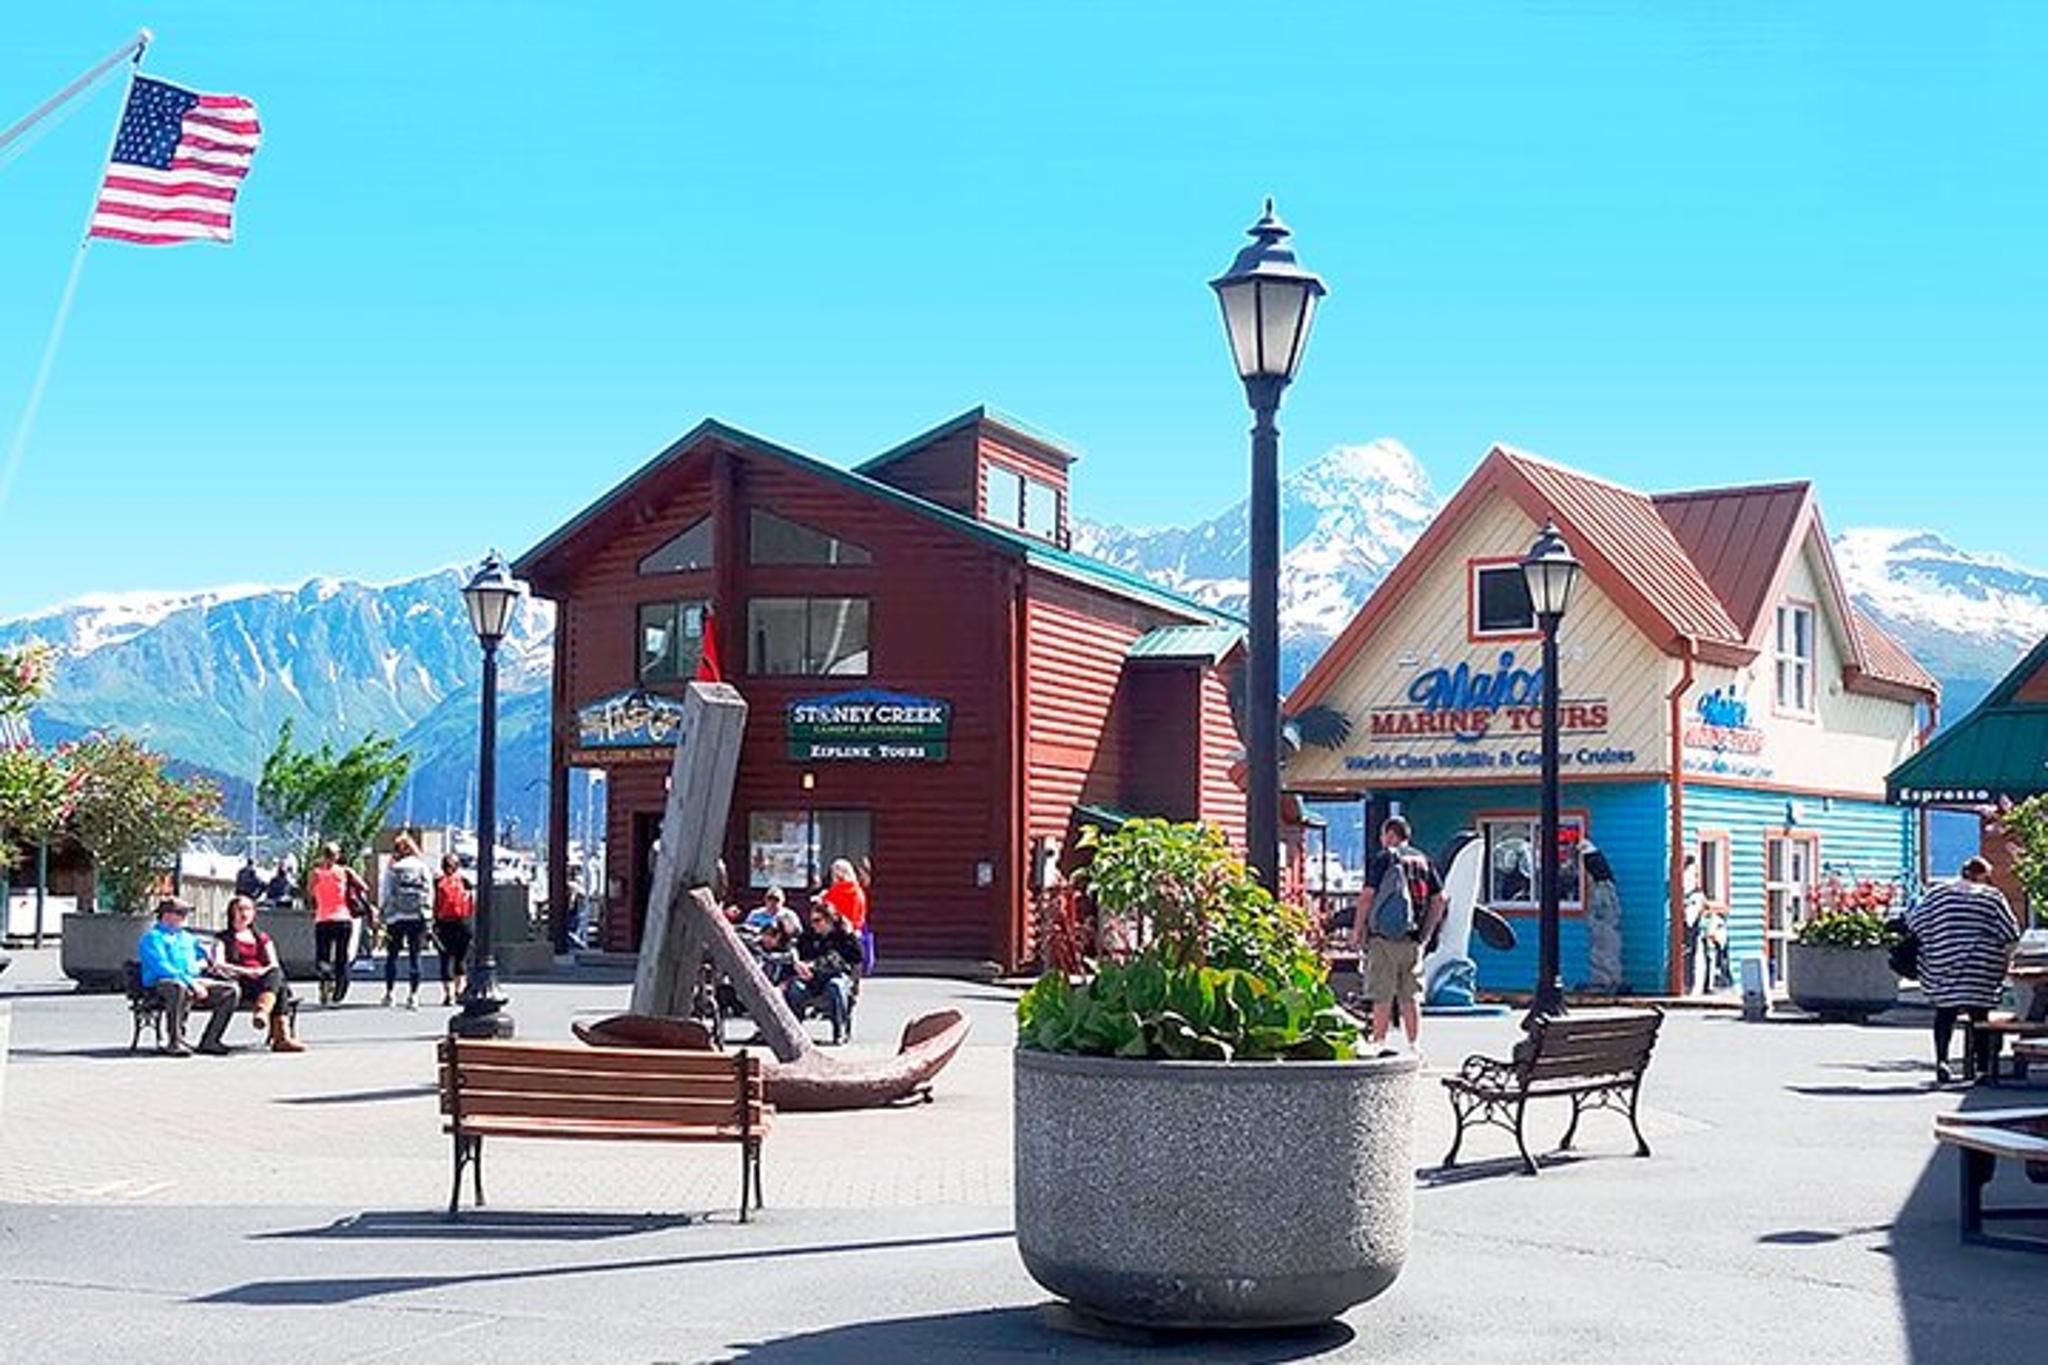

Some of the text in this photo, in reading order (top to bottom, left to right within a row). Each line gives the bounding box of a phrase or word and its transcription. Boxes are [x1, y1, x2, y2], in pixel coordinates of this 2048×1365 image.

[793, 705, 943, 723] STONEY CREEK
[1370, 709, 1491, 735] MARINE
[879, 745, 926, 758] TOURS
[1576, 748, 1637, 766] Cruises
[1900, 788, 1989, 803] Espresso
